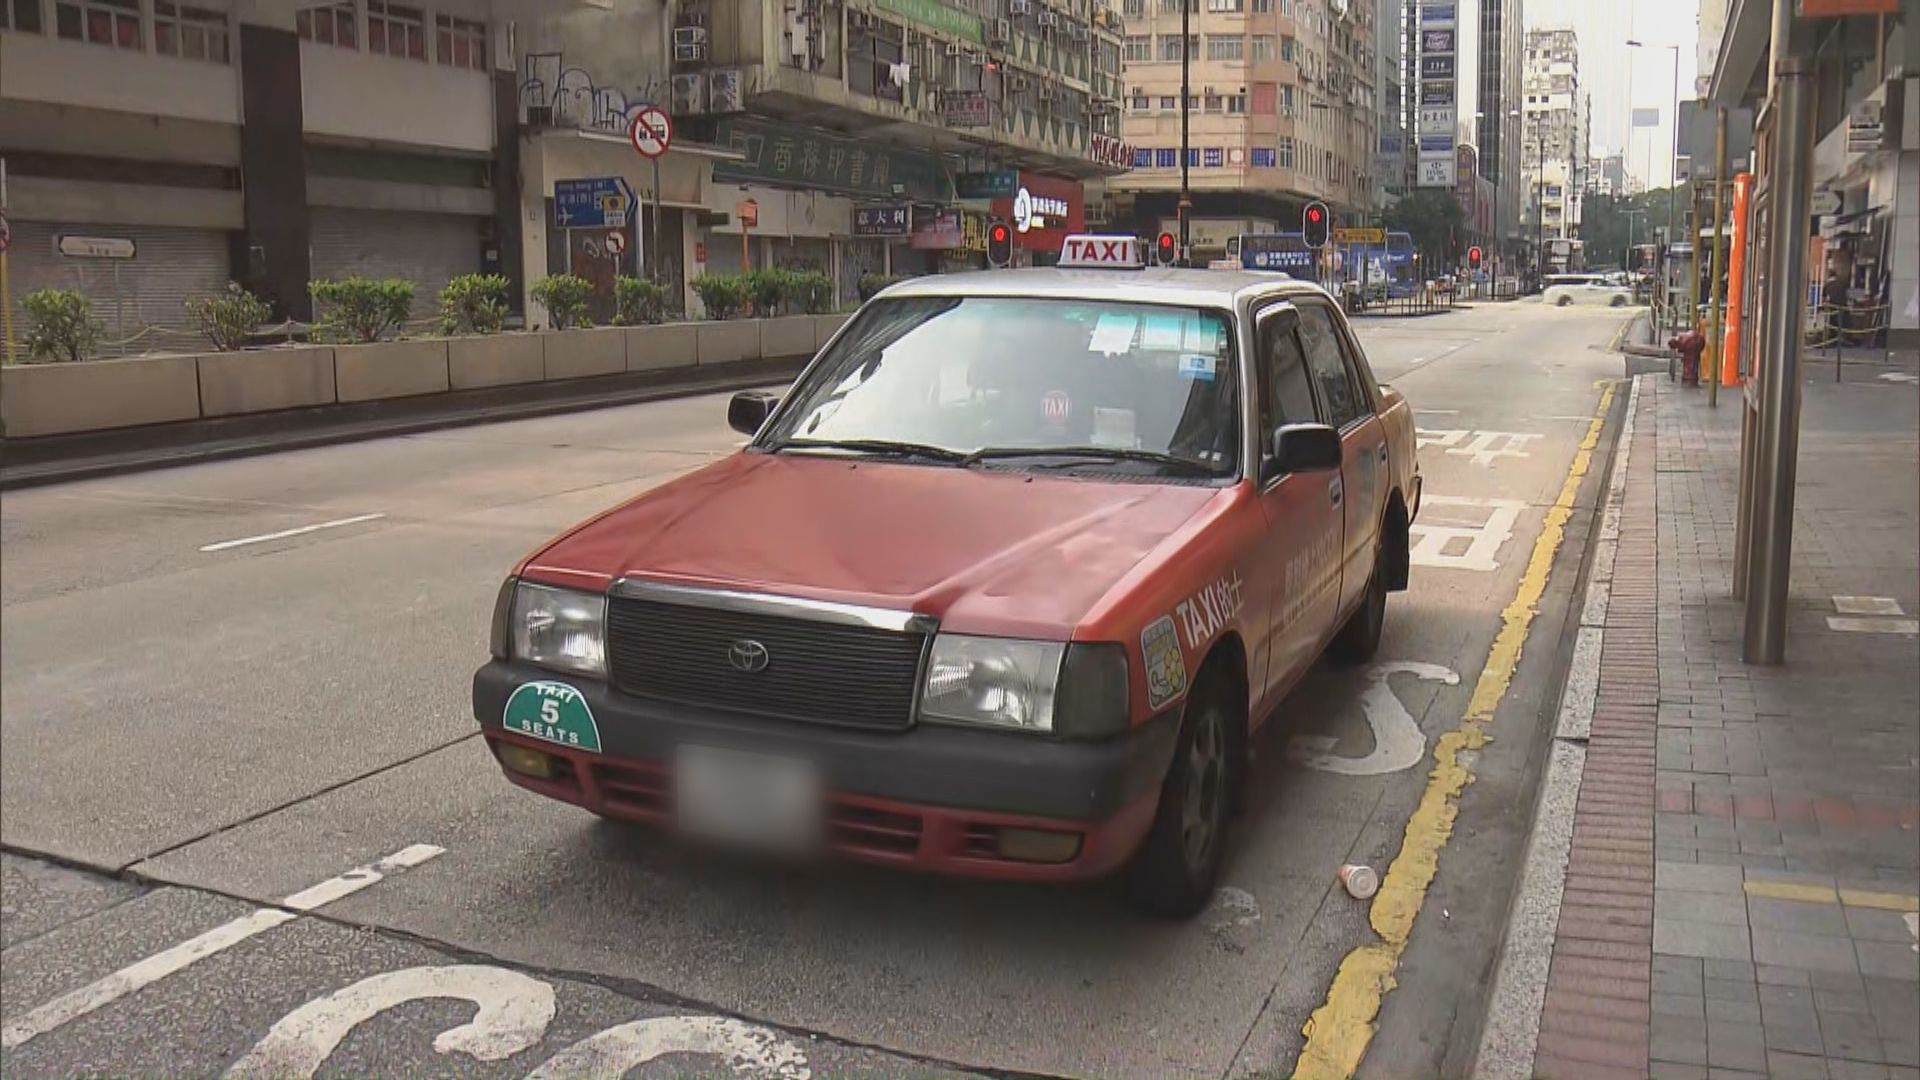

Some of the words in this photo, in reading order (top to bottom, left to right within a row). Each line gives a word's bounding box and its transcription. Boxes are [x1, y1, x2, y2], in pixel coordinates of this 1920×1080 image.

[1067, 240, 1128, 261] TAXI
[1044, 398, 1069, 417] TAXI
[1176, 584, 1223, 650] TAXI
[535, 682, 576, 704] TAXI
[540, 698, 560, 725] 5
[522, 720, 579, 744] SEATS
